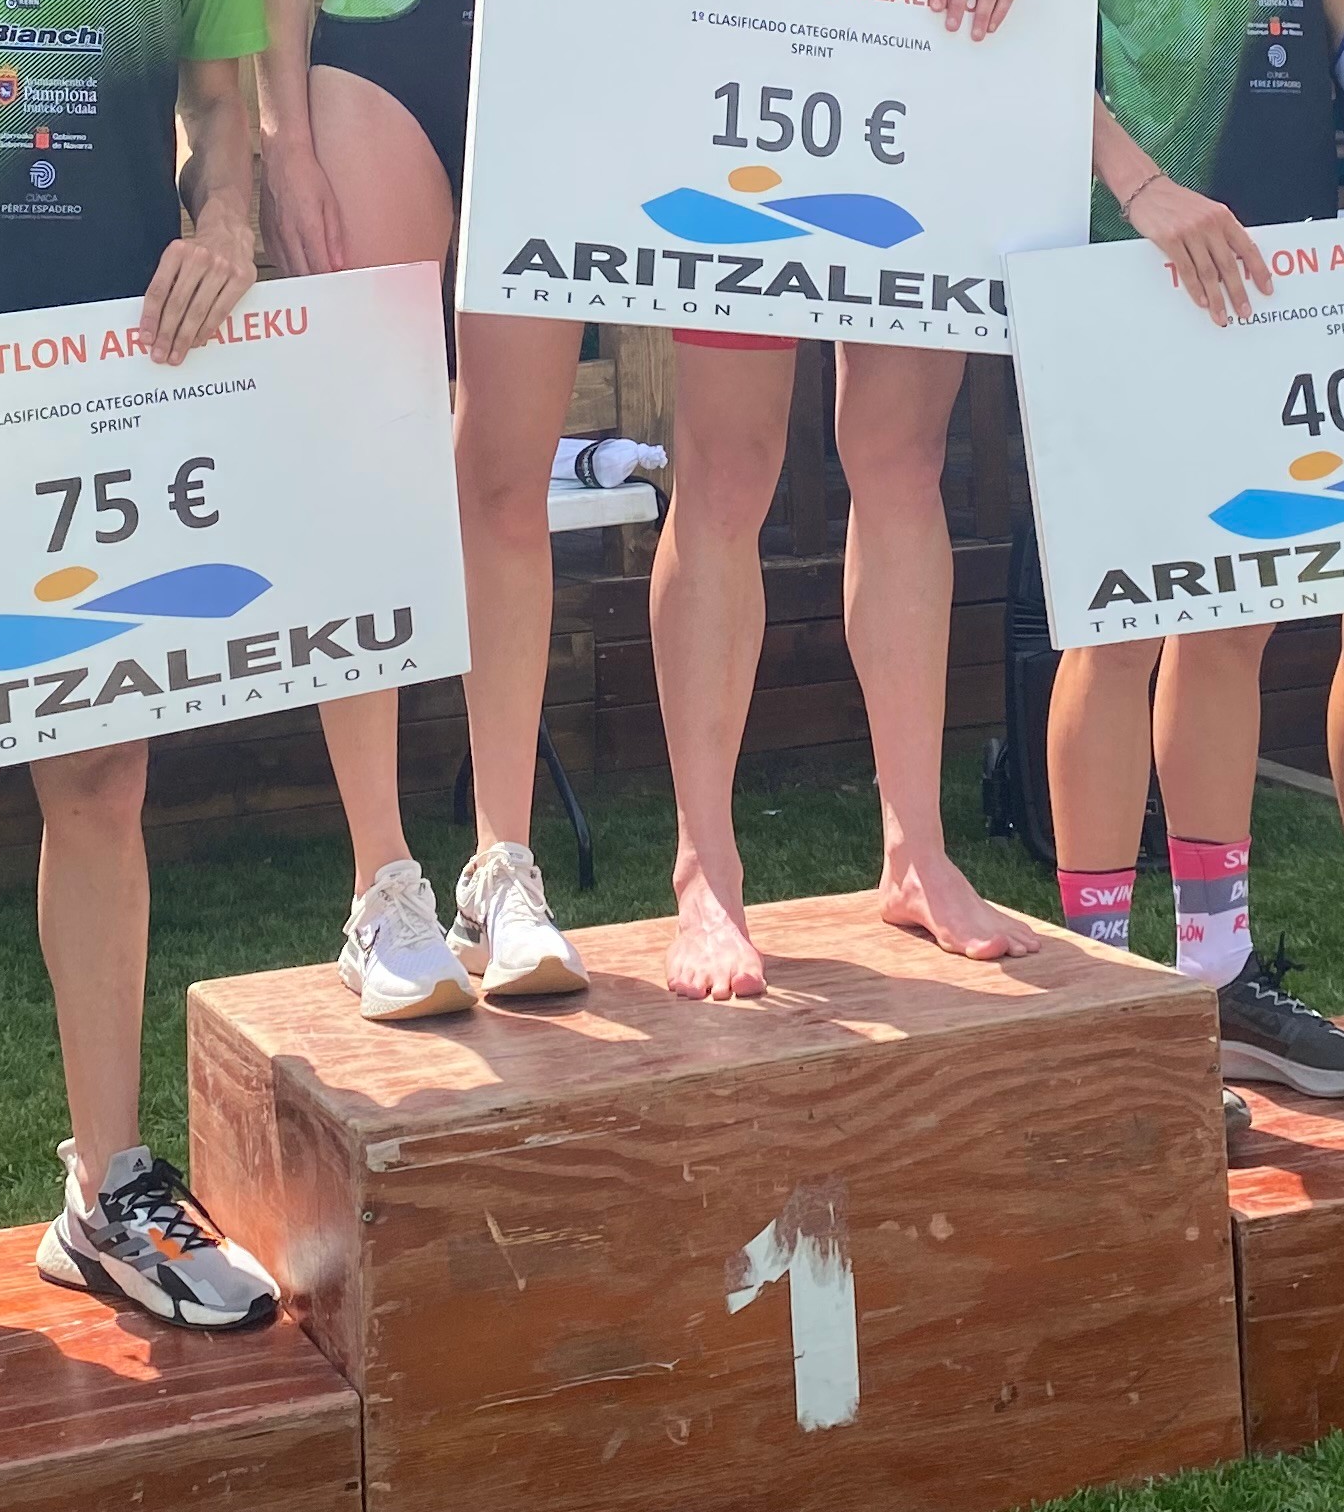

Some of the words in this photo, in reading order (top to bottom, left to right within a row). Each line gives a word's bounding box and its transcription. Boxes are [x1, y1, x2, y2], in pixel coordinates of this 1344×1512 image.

[708, 12, 787, 33] CLASIFICADO
[790, 23, 858, 43] CATEGORÍA
[861, 33, 932, 52] MASCULINA
[791, 42, 834, 59] SPRINT
[23, 87, 97, 105] Pamplona
[66, 104, 97, 114] Udala
[712, 81, 842, 158] 150
[864, 99, 908, 165] €
[1, 203, 29, 213] PÉREZ
[32, 204, 82, 214] ESPADERO
[502, 286, 731, 316] TRIATLON
[1238, 306, 1318, 326] CLASIFICADO
[86, 387, 169, 414] CATEGORÍA
[173, 378, 257, 402] MASCULINA
[90, 415, 141, 434] SPRINT
[35, 468, 139, 553] 75
[168, 456, 220, 529] €
[1090, 592, 1319, 633] TRIATLON
[150, 657, 418, 720] TRIATLOIA
[726, 1178, 859, 1431] 1
